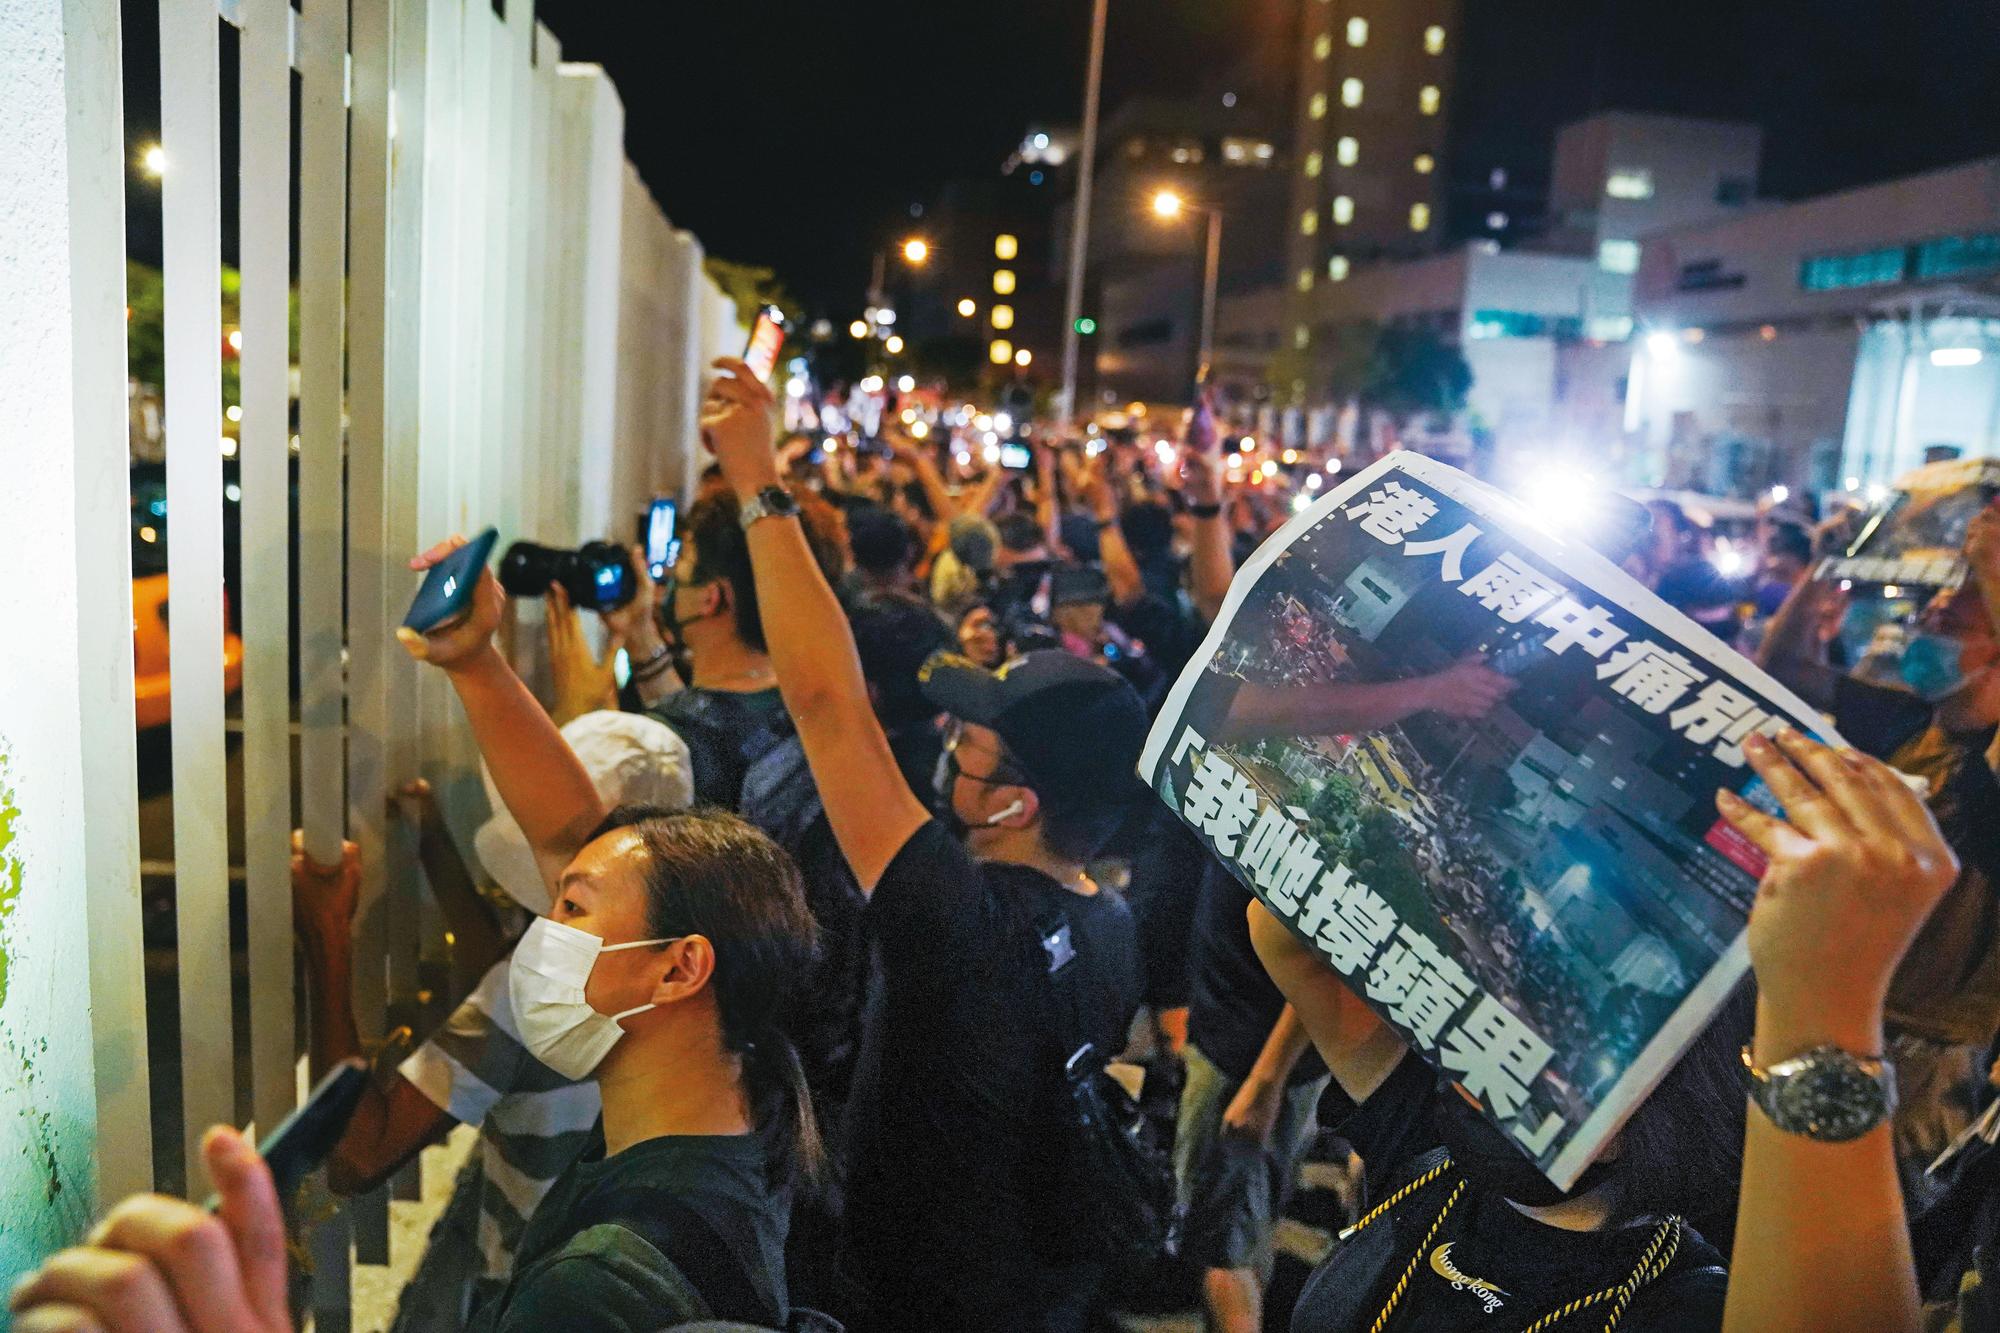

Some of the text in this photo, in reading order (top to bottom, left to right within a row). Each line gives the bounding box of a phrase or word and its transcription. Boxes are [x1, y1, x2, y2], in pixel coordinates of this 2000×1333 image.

[1345, 481, 1791, 768] 港人雨中痛別
